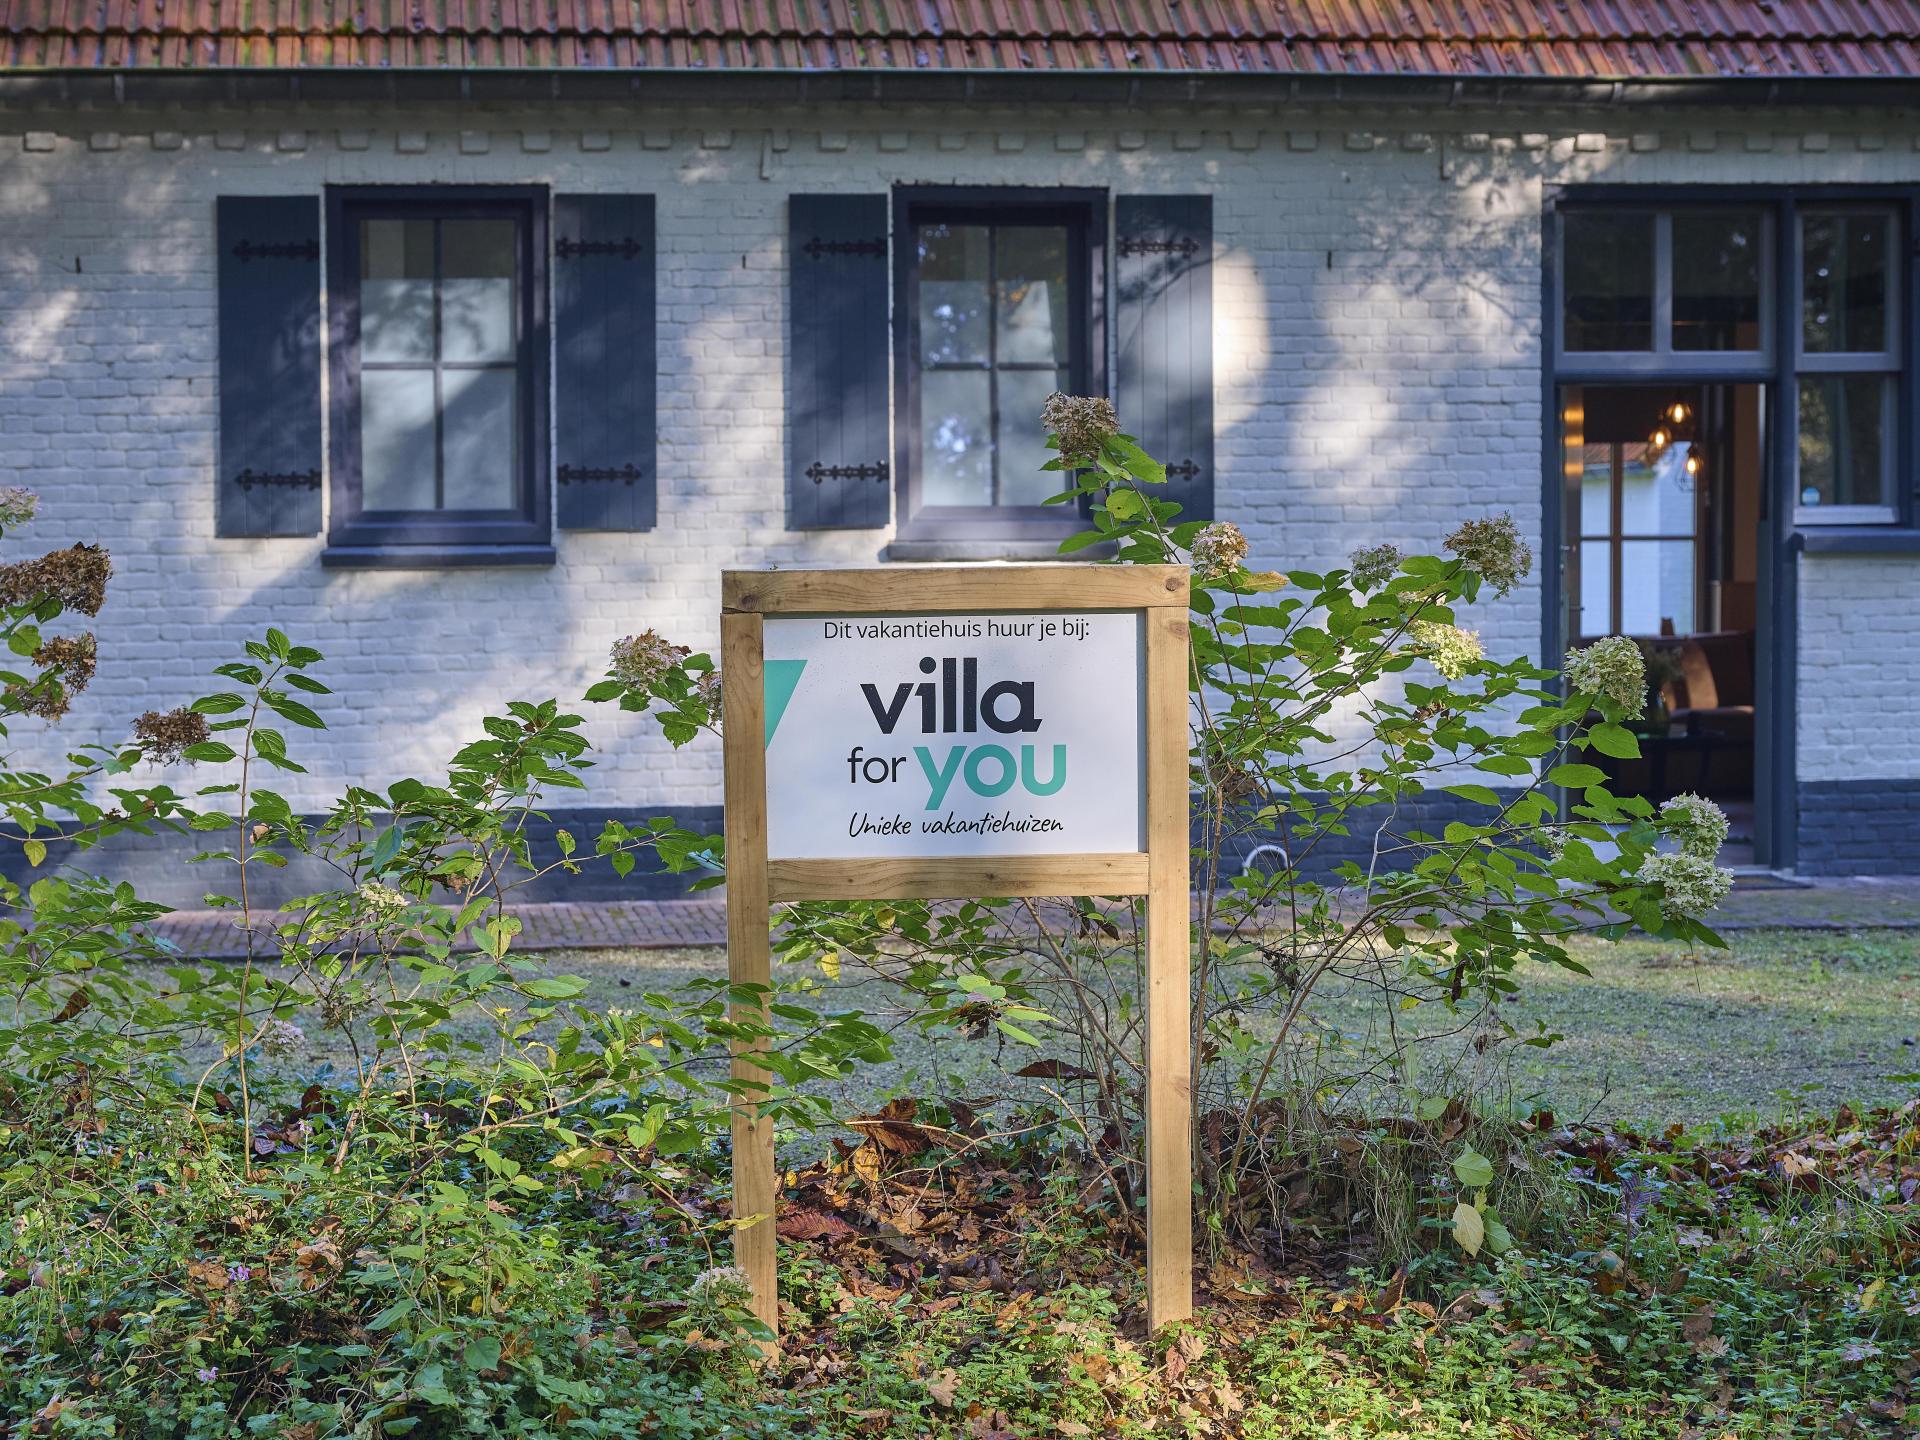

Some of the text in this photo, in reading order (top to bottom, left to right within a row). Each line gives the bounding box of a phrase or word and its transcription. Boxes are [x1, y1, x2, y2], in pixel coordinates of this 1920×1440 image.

[824, 617, 1090, 642] Dit vakantiehuis huur je bij:
[860, 656, 1043, 735] villa
[847, 744, 1067, 811] for you
[848, 810, 1064, 838] Unieke vakantiehuizen
